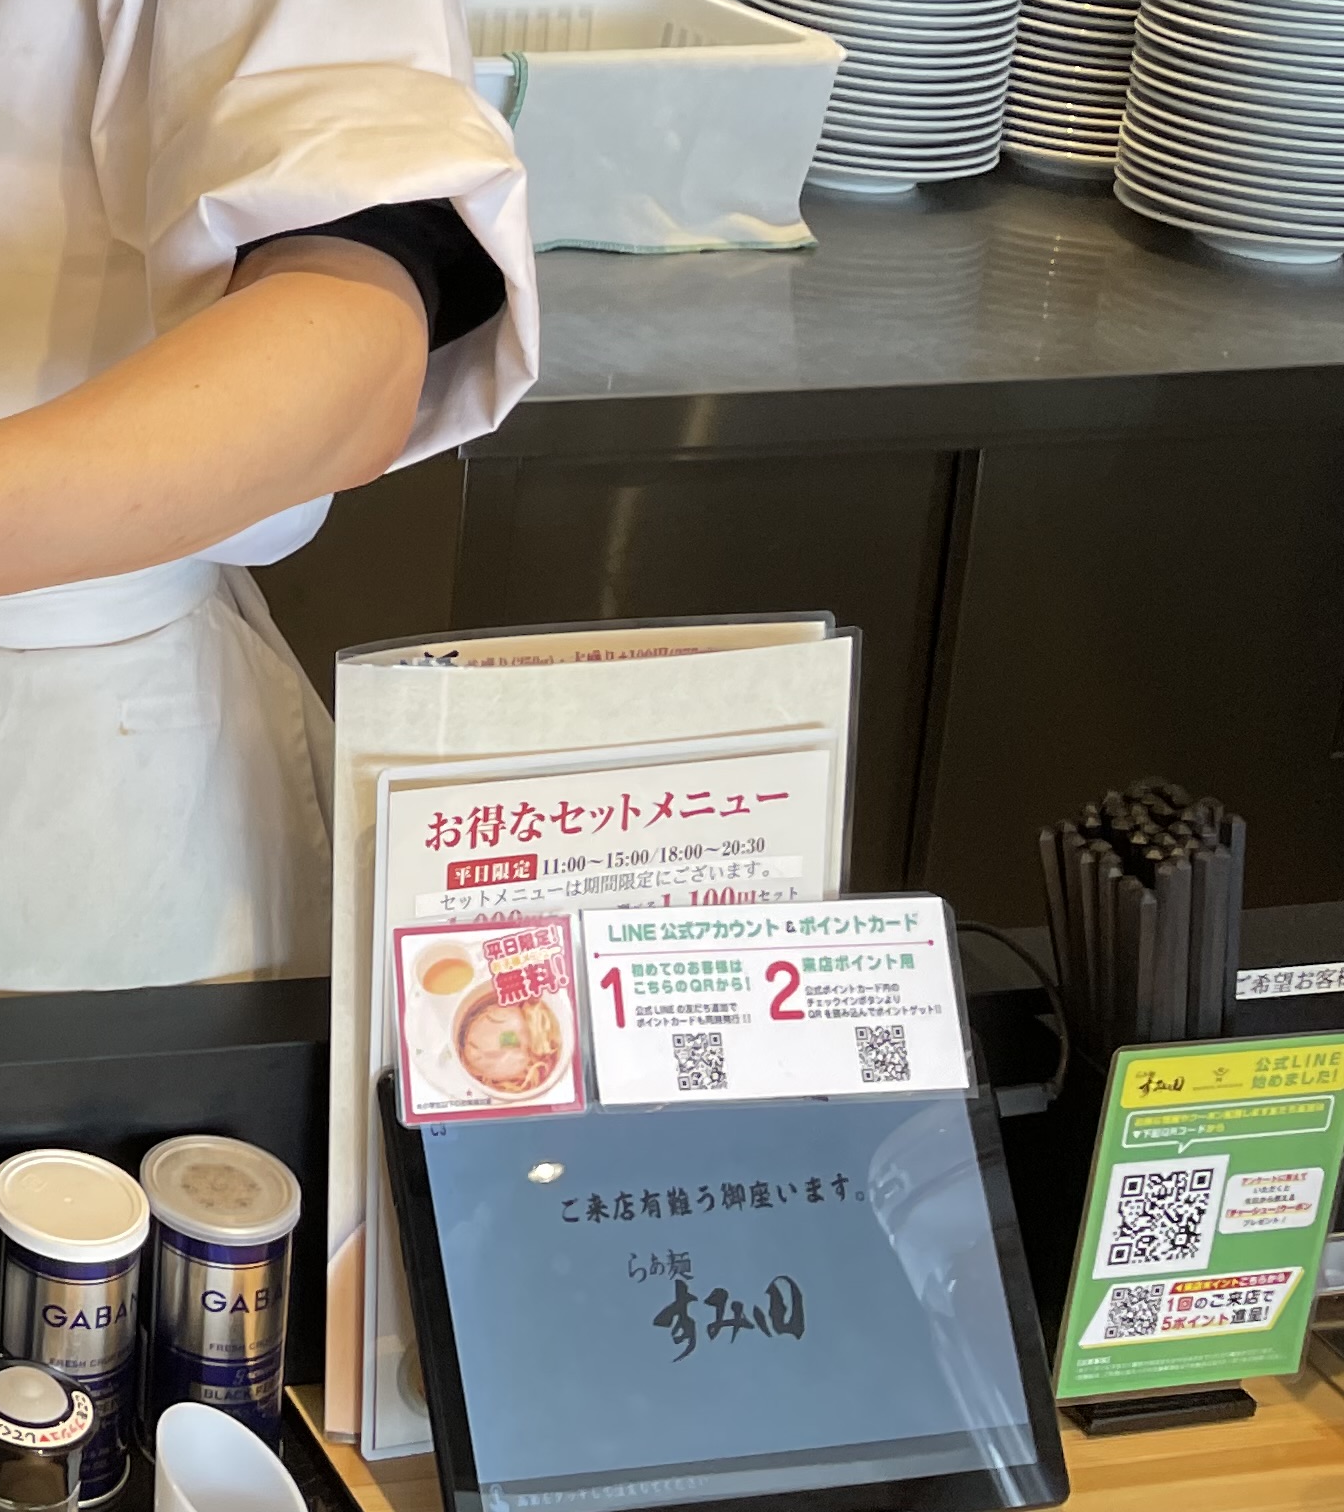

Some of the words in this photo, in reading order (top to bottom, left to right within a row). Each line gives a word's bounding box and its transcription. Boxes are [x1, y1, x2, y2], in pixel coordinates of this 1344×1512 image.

[424, 790, 791, 852] お得なセットメニュー
[440, 859, 771, 911] セットメニューは期間限定にございます。
[454, 859, 531, 884] 平日限定
[608, 923, 657, 943] LINE
[661, 919, 779, 941] 公式アカウント
[799, 913, 919, 936] ポイントカード
[601, 967, 625, 1028] 1
[765, 960, 805, 1020] 2
[1255, 1052, 1342, 1073] 公式LINE
[561, 1173, 866, 1223] ご来店有難う御座います。
[1166, 1290, 1275, 1313] 1回のご来店で
